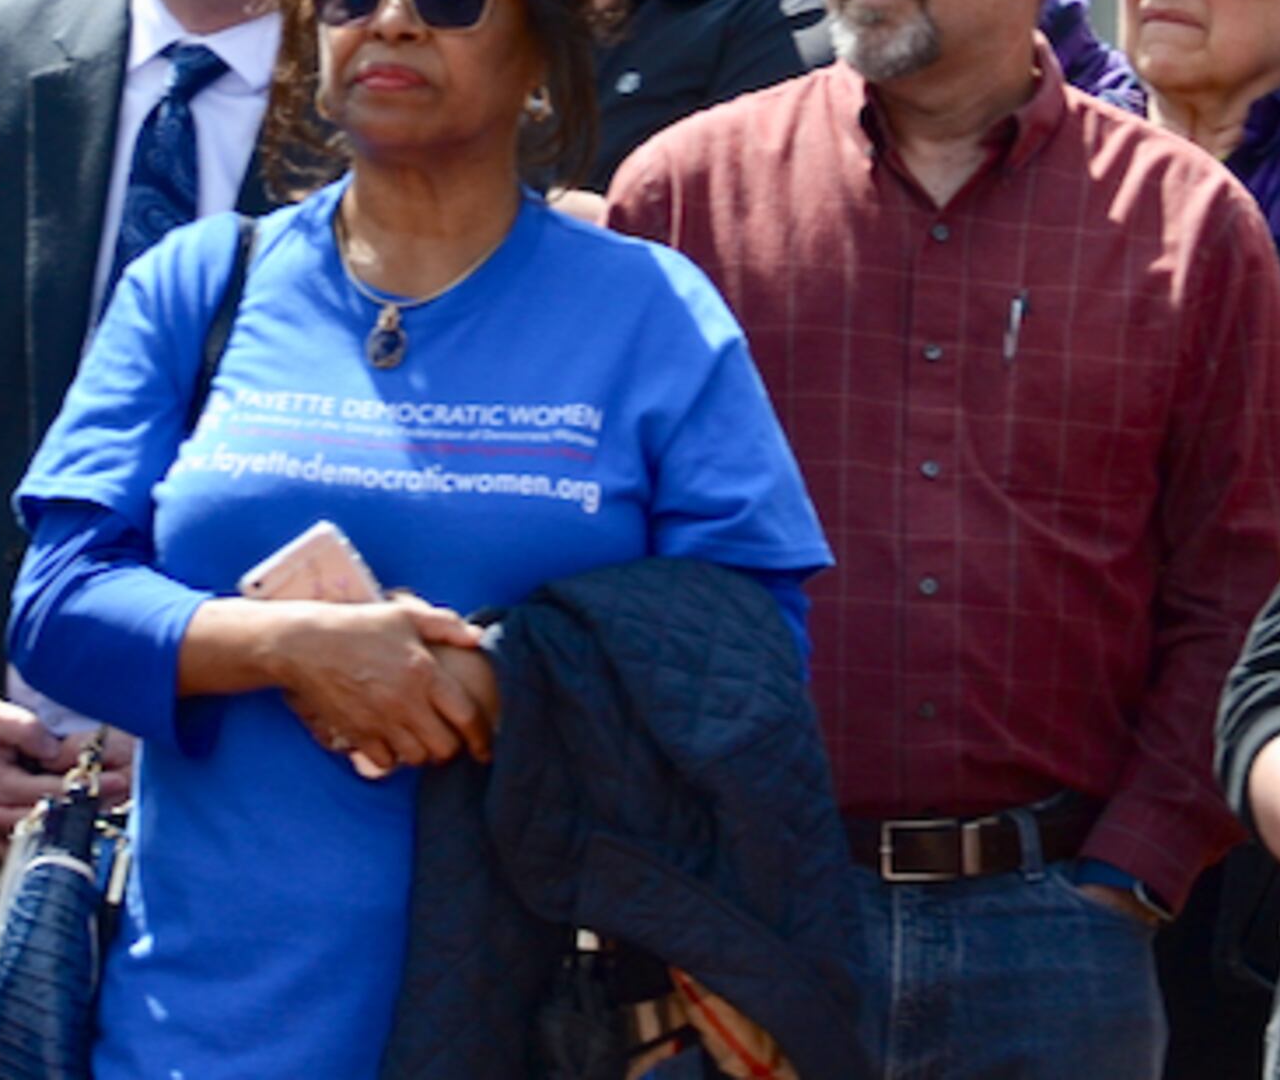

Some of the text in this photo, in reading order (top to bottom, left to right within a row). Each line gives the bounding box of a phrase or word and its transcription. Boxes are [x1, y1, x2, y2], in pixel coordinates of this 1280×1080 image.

[234, 390, 336, 417] FAYETTE
[340, 397, 506, 427] DEMOCRATIC
[509, 404, 603, 431] WOMEN
